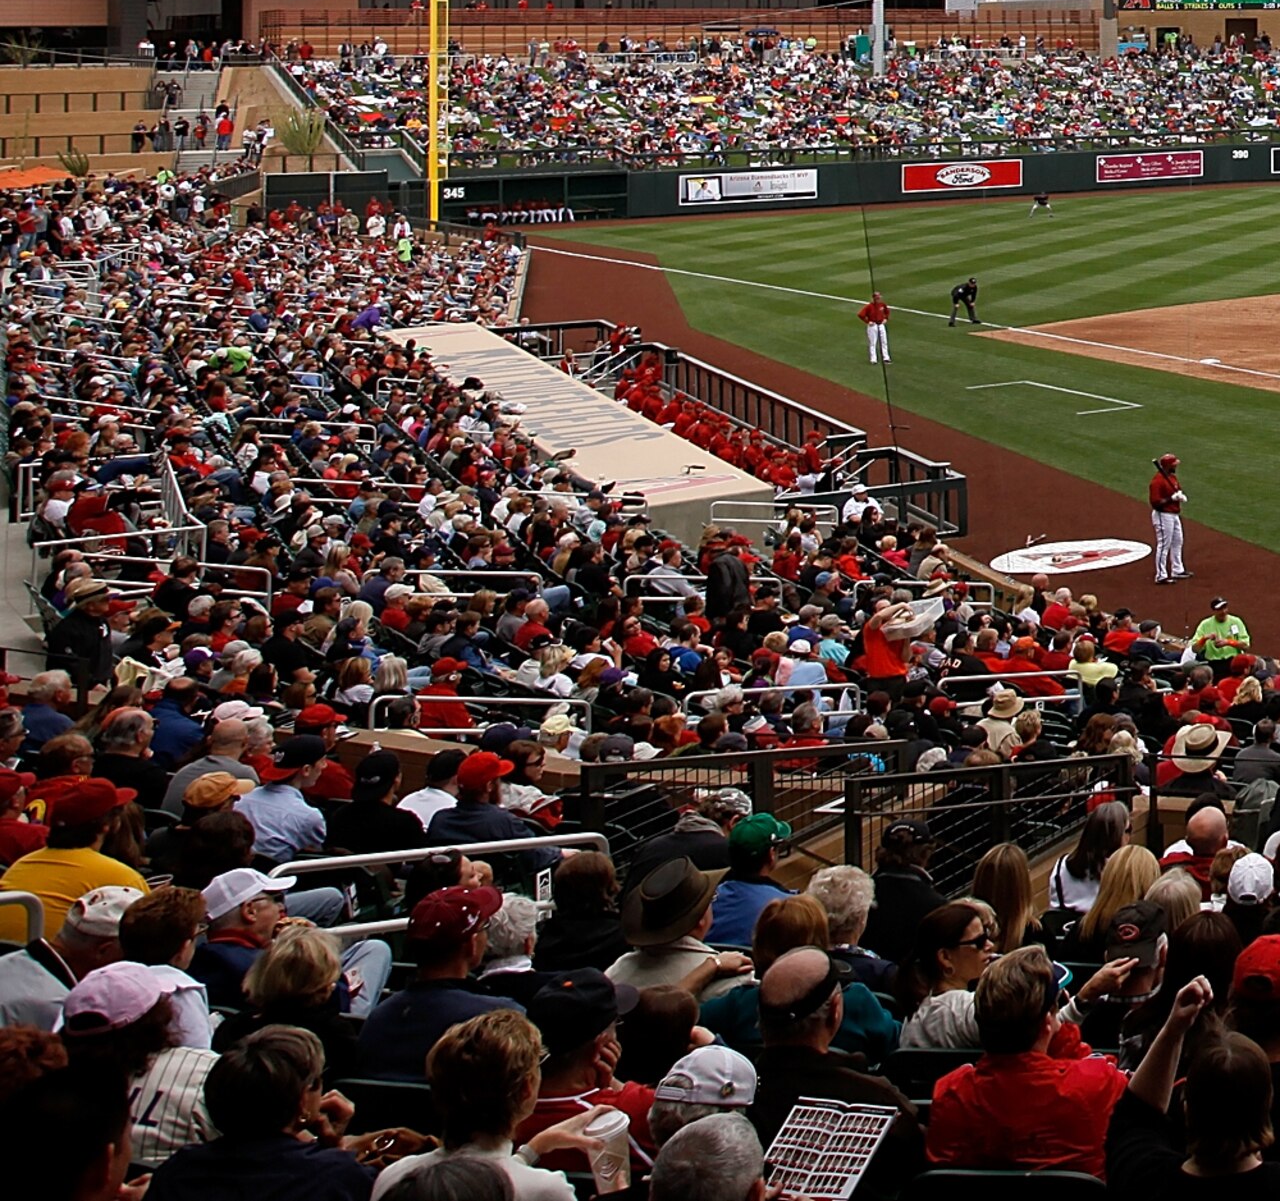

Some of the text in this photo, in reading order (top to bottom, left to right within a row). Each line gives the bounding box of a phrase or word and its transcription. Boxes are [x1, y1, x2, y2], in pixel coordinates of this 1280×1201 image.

[1232, 150, 1249, 159] 390
[940, 167, 986, 179] SANDERSON
[951, 173, 974, 184] Ford
[443, 186, 465, 199] 345
